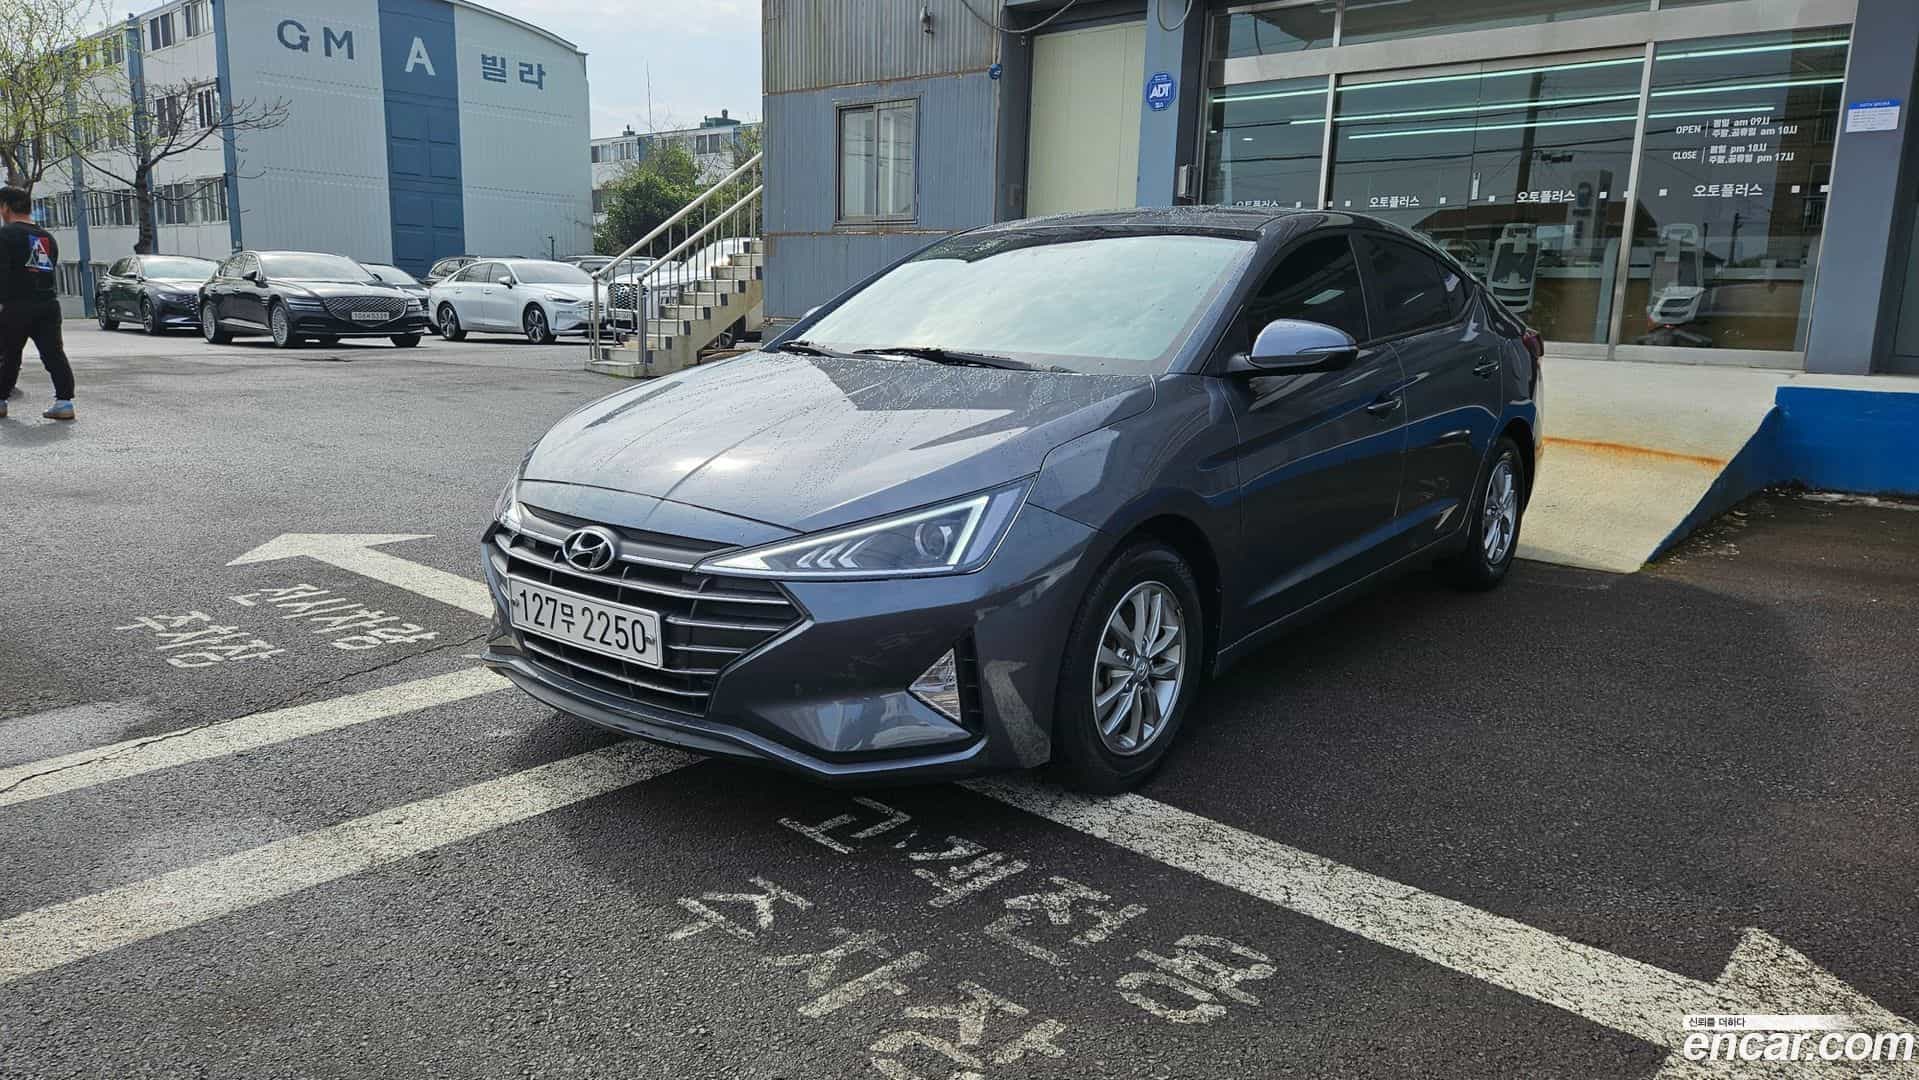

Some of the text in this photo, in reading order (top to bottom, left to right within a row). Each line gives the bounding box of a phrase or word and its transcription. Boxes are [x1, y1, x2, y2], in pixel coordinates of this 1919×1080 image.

[404, 36, 436, 76] A
[481, 54, 546, 90] 빌라
[1150, 83, 1172, 98] ADT
[1675, 125, 1701, 134] OPEN
[1778, 125, 1798, 135] 10시
[1672, 151, 1697, 160] CLOSE
[1730, 146, 1745, 154] pm
[1756, 155, 1772, 164] pm
[1774, 152, 1795, 161] 17시
[1516, 188, 1576, 204] 오토플러스
[1692, 183, 1764, 198] 오토플러스
[1368, 195, 1420, 208] 오토플러스
[230, 583, 441, 650] 전시차량
[519, 589, 647, 654] 127무 2250
[114, 610, 286, 668] 주차장
[779, 796, 1278, 1025] 고객전용
[668, 875, 1067, 1080] 주차장
